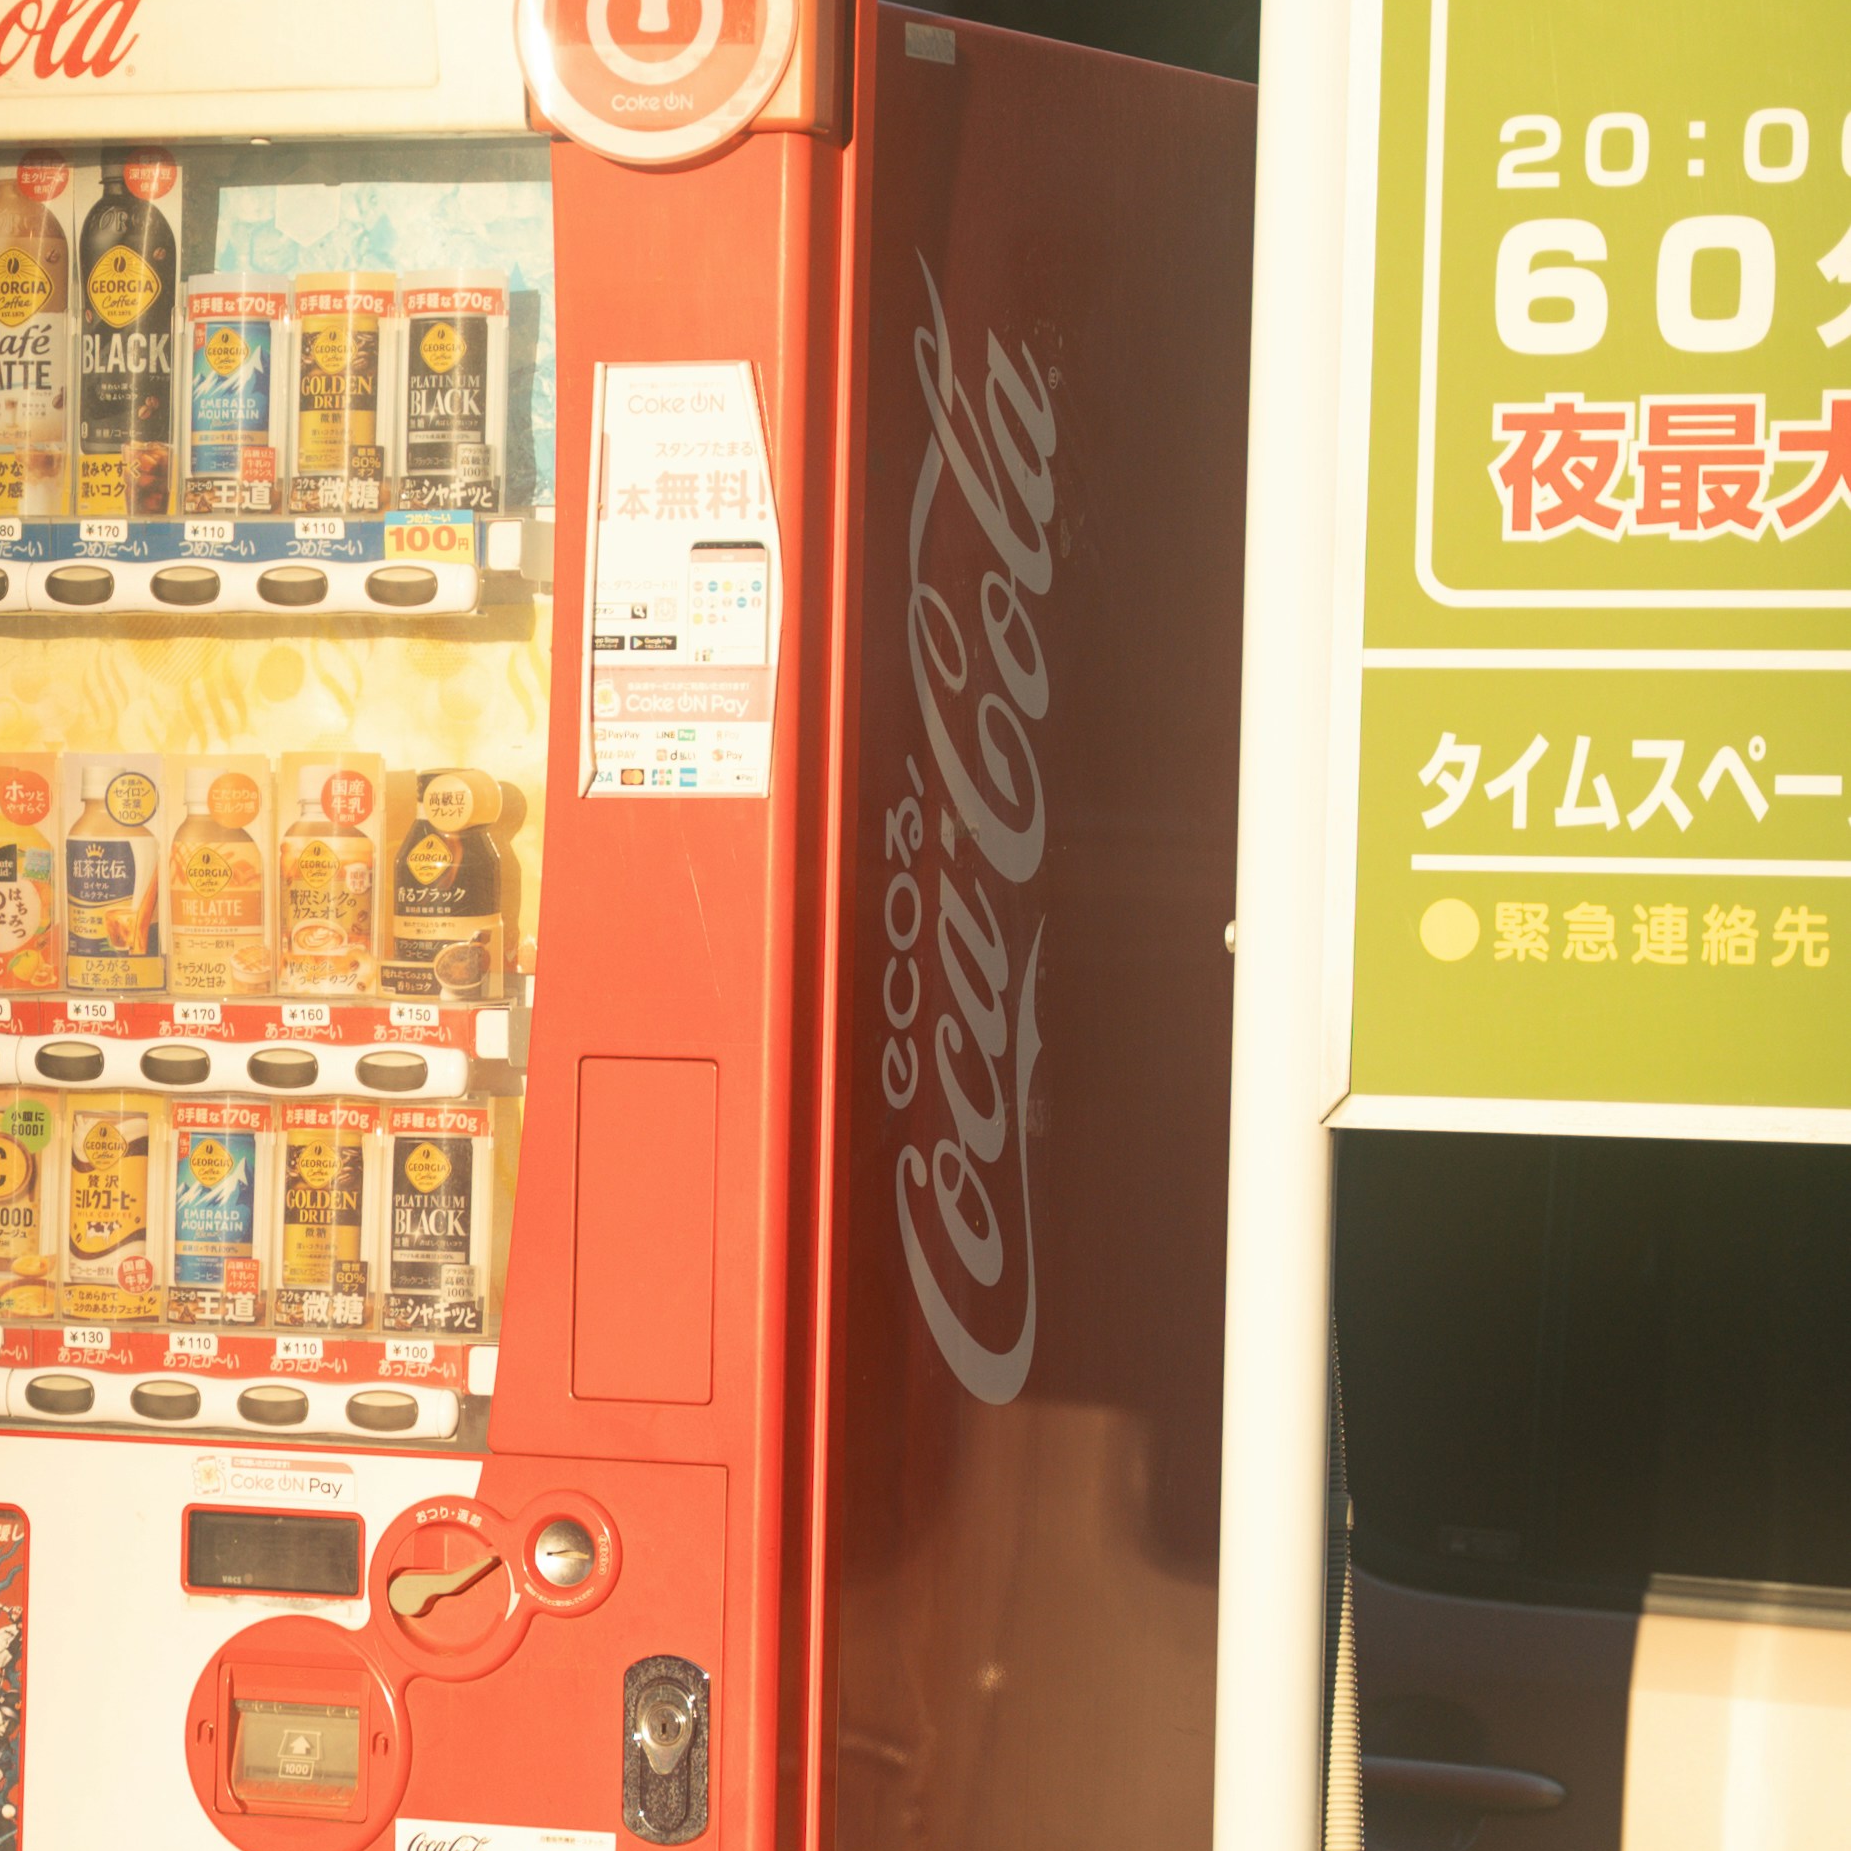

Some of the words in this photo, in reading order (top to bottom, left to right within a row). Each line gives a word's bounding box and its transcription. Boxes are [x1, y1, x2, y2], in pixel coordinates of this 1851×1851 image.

[611, 94, 660, 112] Coke
[1497, 106, 1851, 189] 20:0
[82, 334, 172, 375] BLACK
[301, 376, 374, 396] GOLDEN
[410, 375, 481, 390] PLATINUM
[410, 389, 482, 416] BLACK
[628, 394, 685, 414] Coke
[213, 480, 274, 511] 王道
[319, 478, 381, 510] 微糖
[420, 481, 494, 511] シャキッと
[86, 523, 120, 539] ¥170
[191, 525, 225, 540] ¥110
[301, 521, 336, 536] ¥110
[388, 526, 470, 553] 100円
[625, 694, 674, 712] Coke
[711, 694, 749, 717] Pay
[331, 779, 366, 797] 国産
[331, 797, 365, 815] 牛乳
[895, 246, 1057, 1406] Coca-Cola
[72, 858, 127, 879] 紅茶花伝
[398, 887, 467, 902] 香るブラック
[8, 887, 29, 939] はちみつ
[1493, 900, 1830, 967] 緊急連絡先
[85, 959, 131, 972] ひろがる
[81, 973, 138, 987] 紅茶の余韻
[72, 1004, 107, 1018] ¥150
[182, 1009, 215, 1021] ¥170
[289, 1009, 323, 1021] ¥160
[397, 1008, 431, 1021] ¥150
[75, 1189, 137, 1209] ミルクコーヒー
[287, 1189, 358, 1210] GOLDEN
[394, 1194, 465, 1208] PLATINUM
[183, 1209, 240, 1221] EMERALD
[394, 1208, 466, 1236] BLACK
[181, 1220, 243, 1232] MOUNTAIN
[194, 1292, 256, 1323] 王道
[302, 1291, 364, 1325] 微糖
[404, 1300, 477, 1328] シャキッと
[230, 1473, 275, 1491] Coke
[309, 1477, 343, 1499] Pay
[283, 1762, 310, 1777] 1000
